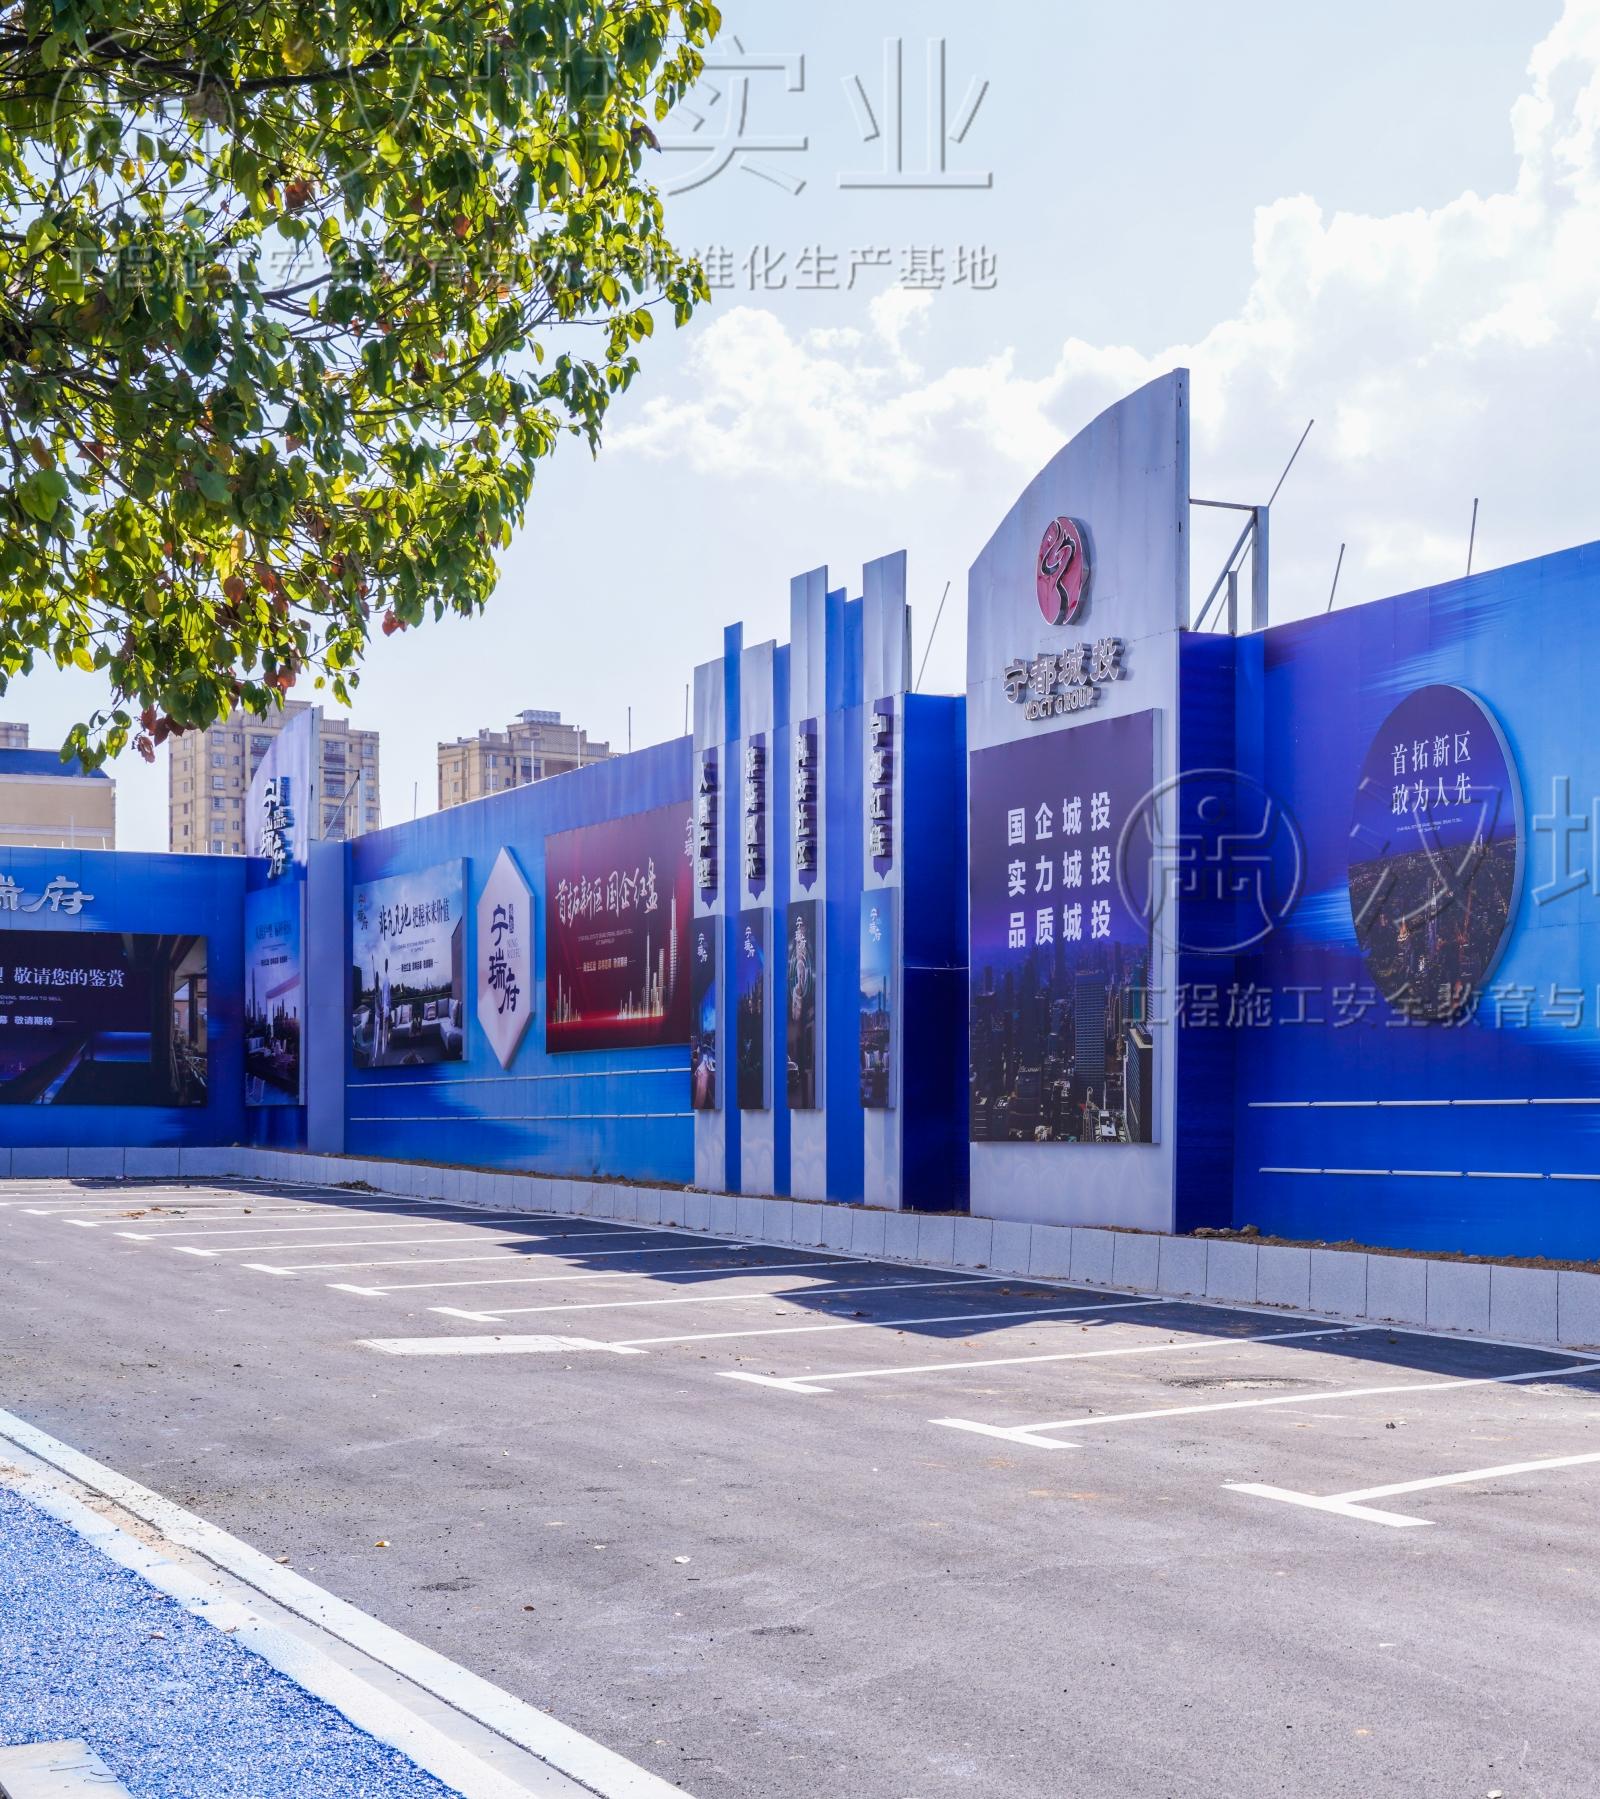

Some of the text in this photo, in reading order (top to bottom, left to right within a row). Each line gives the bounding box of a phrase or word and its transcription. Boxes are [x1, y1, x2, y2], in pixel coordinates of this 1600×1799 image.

[1003, 636, 1124, 704] 宁都城投
[1055, 686, 1098, 714] GROUP
[1392, 730, 1472, 776] 首拓新区
[1392, 772, 1472, 816] 敢为人先
[1008, 791, 1111, 847] 国企城投
[1008, 846, 1111, 897] 实力城投
[1008, 900, 1111, 949] 品质城投
[14, 966, 126, 988] 敬请您的鉴赏
[488, 903, 520, 1015] 宁瑞府
[14, 1015, 53, 1025] 敬请期待
